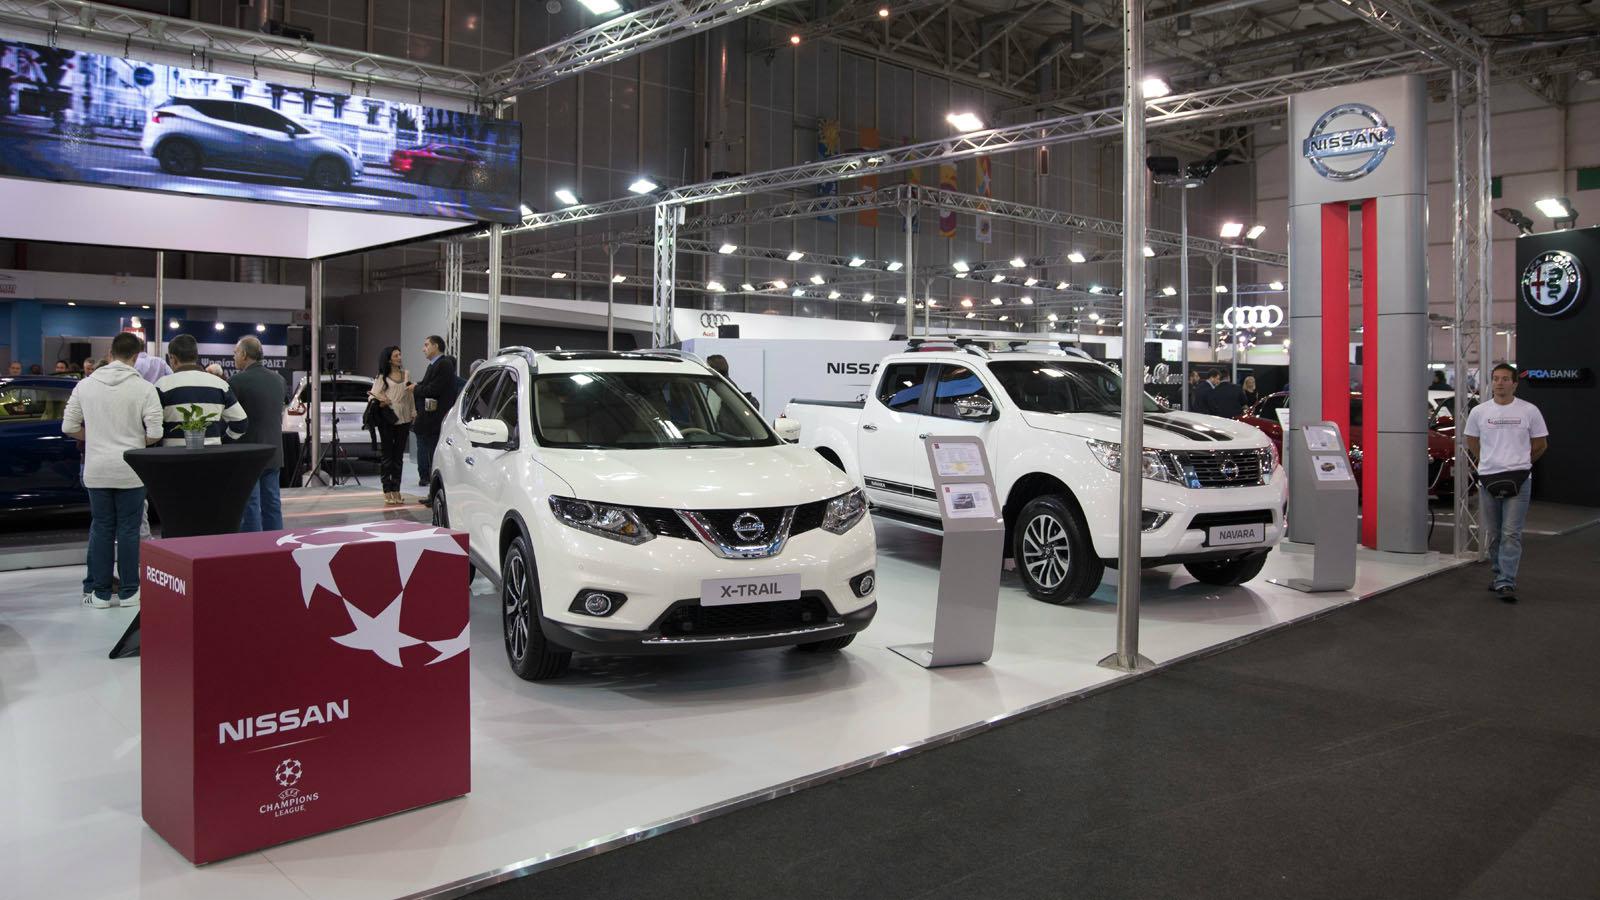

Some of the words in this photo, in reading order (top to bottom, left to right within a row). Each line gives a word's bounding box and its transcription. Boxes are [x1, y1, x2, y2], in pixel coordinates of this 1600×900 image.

[1311, 132, 1384, 151] NISSAN
[826, 362, 880, 375] NISSA
[1550, 369, 1578, 378] BANK
[1219, 528, 1256, 540] NAVARA
[146, 565, 186, 596] RECEPTION
[720, 582, 782, 598] X-TRAIL
[218, 698, 349, 745] NISSAN
[280, 788, 299, 799] UEFA
[259, 792, 319, 814] CHAMPIONS
[274, 804, 305, 817] LEAGUE
